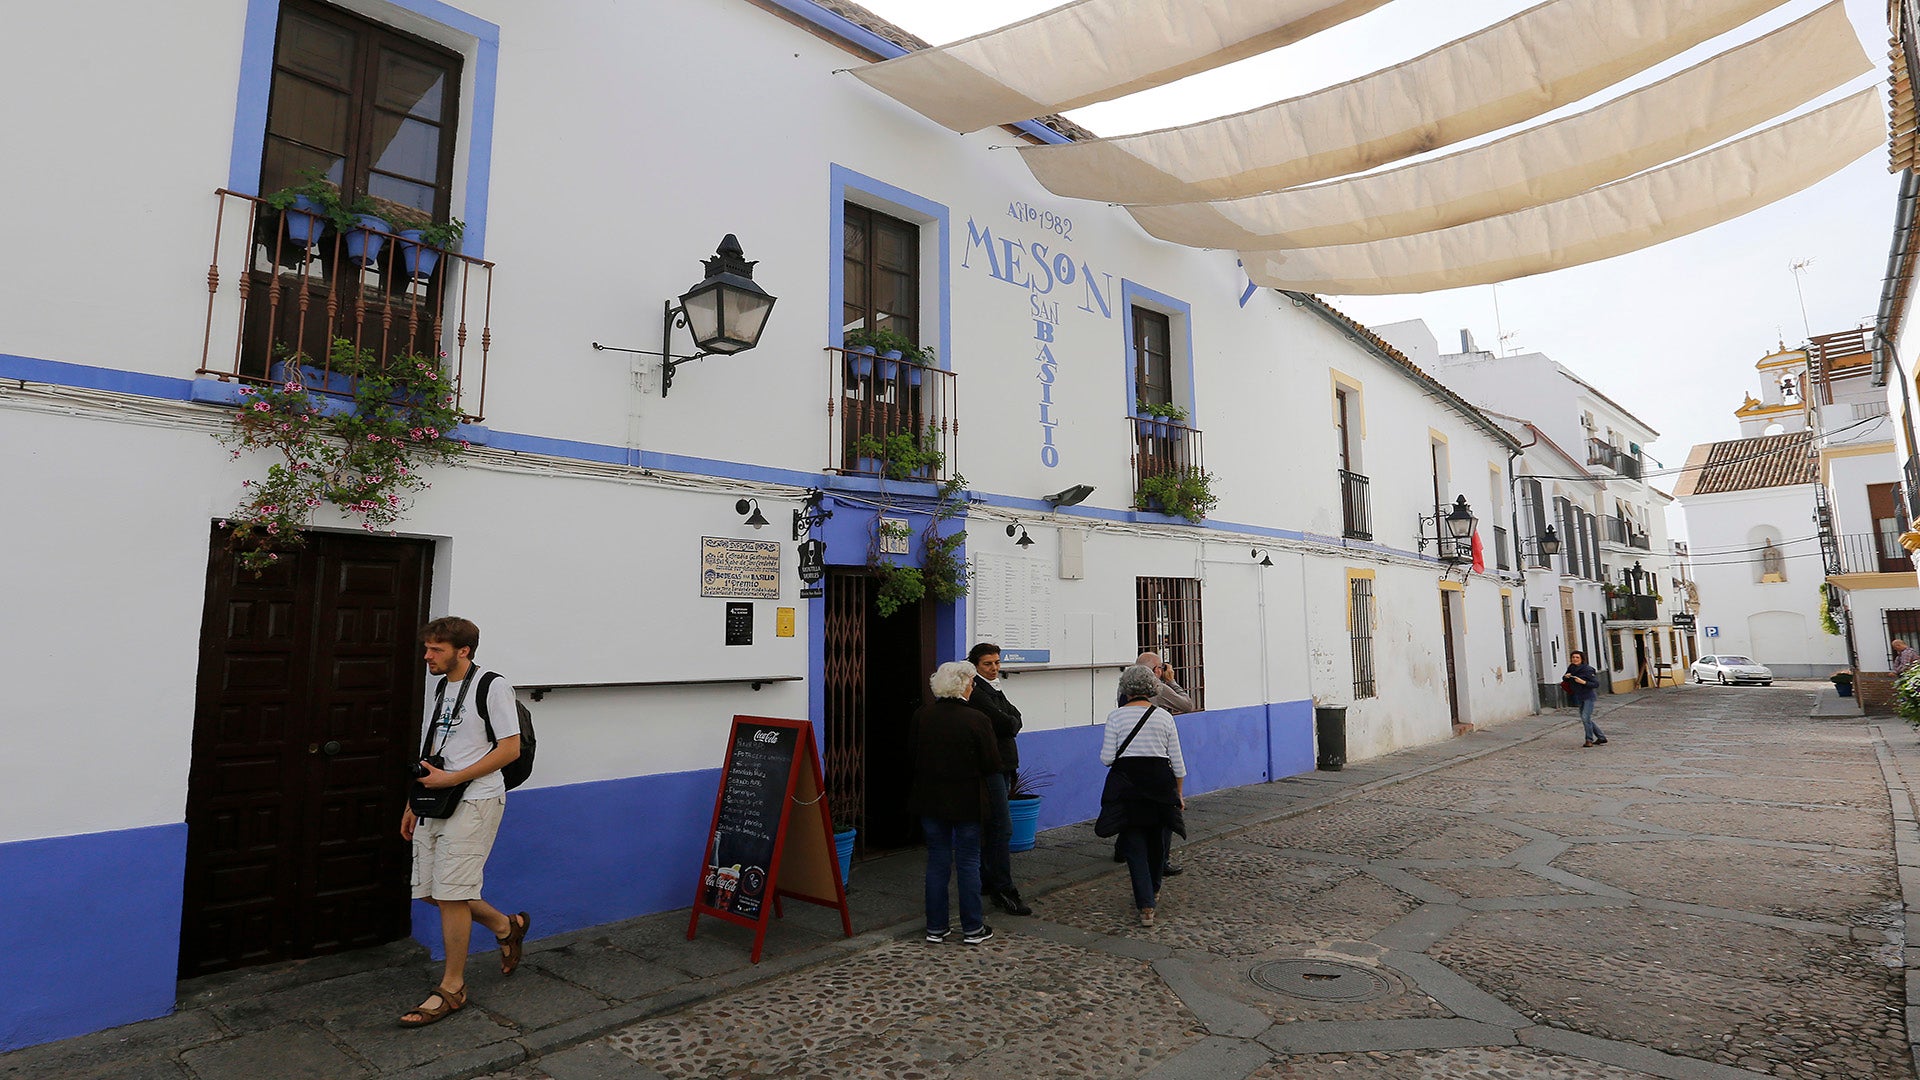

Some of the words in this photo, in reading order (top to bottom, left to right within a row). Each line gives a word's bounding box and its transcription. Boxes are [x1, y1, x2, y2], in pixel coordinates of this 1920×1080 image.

[1039, 211, 1073, 242] 1982
[961, 215, 1112, 319] MESON
[1030, 293, 1060, 325] SAN
[1033, 318, 1060, 468] BASILIO
